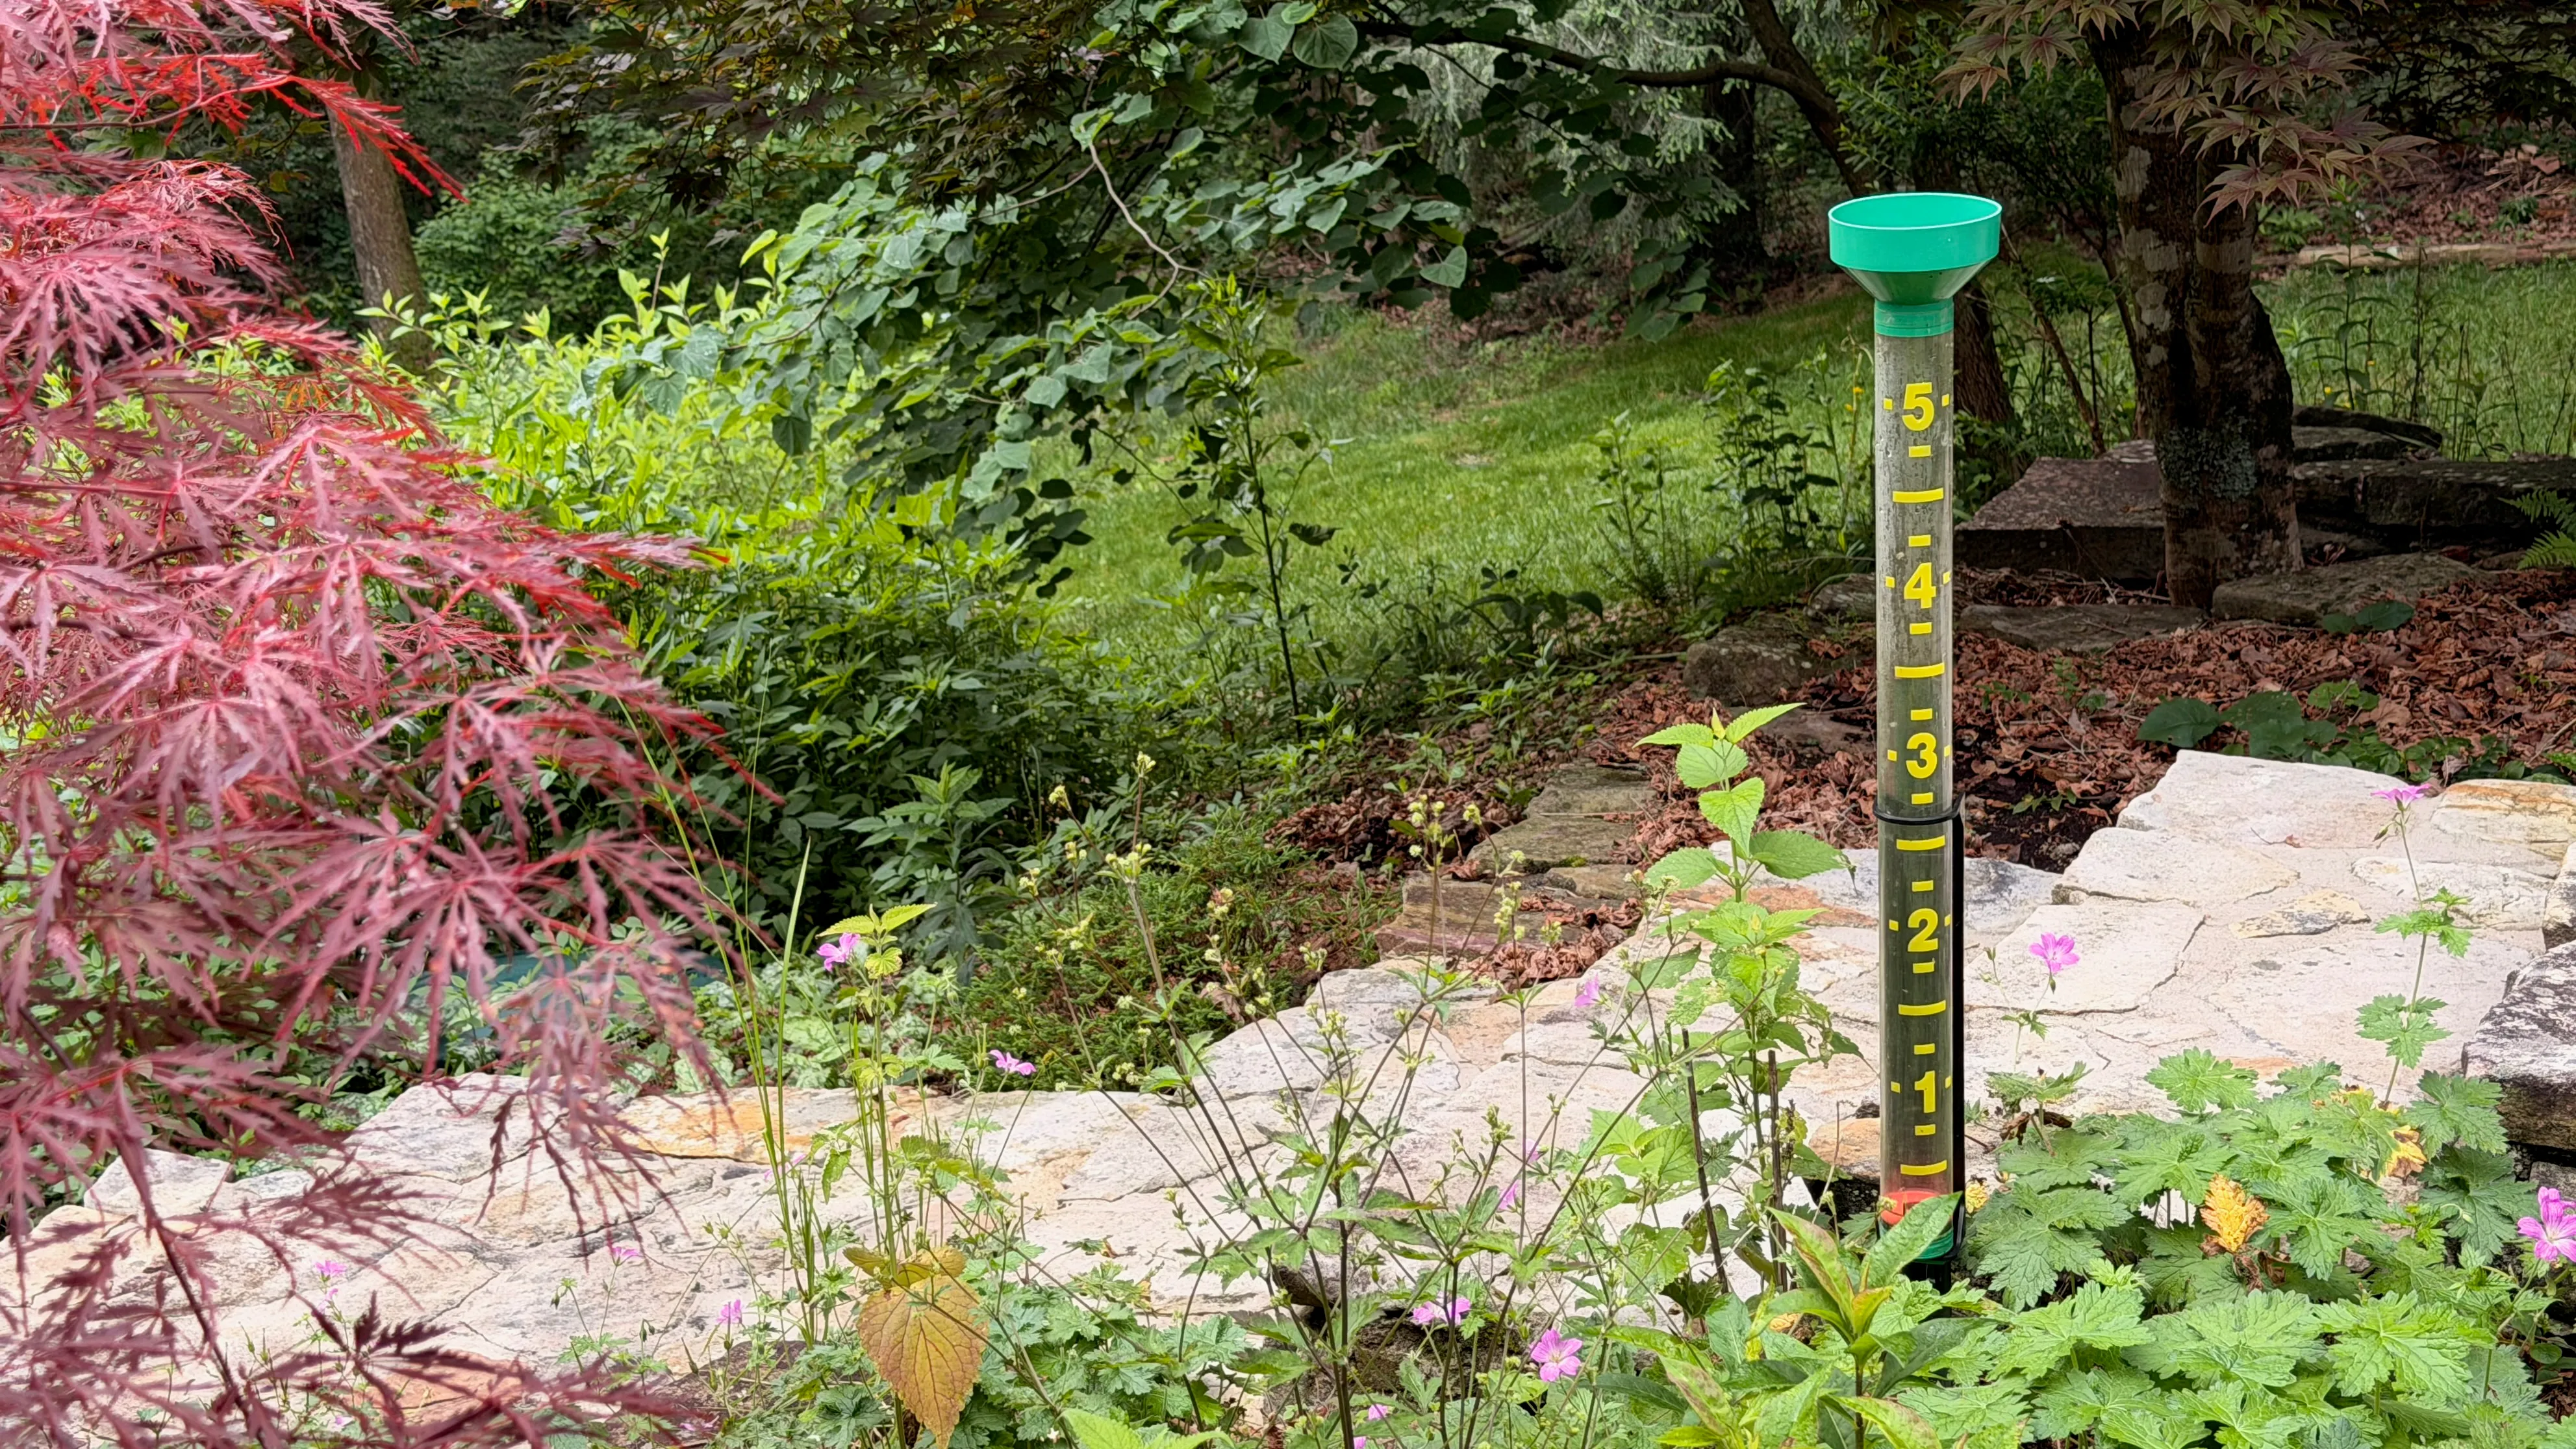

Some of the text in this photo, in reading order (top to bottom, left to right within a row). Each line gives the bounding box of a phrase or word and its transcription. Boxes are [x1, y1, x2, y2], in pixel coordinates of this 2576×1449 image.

[1902, 382, 1935, 431] 5
[1903, 562, 1938, 609] 4
[1906, 732, 1938, 779] 3
[1908, 908, 1939, 952] 2
[1914, 1071, 1936, 1113] 1
